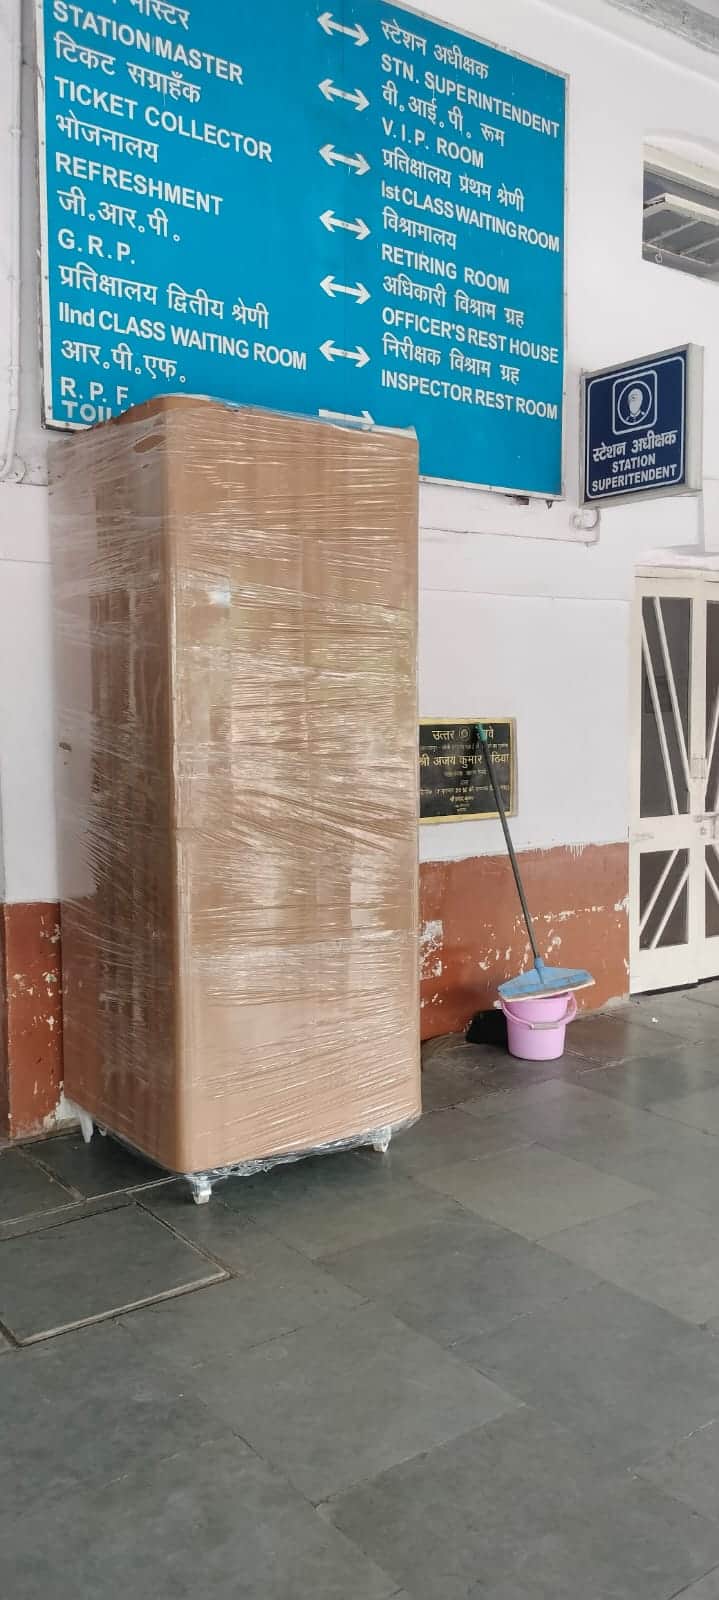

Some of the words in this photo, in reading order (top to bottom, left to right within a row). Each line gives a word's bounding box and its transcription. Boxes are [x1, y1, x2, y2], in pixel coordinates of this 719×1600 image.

[53, 1, 150, 53] STATION
[155, 36, 243, 85] MASTER
[54, 31, 116, 75] टिकट
[380, 20, 427, 56] स्टेशन
[433, 44, 489, 79] अधीक्षक
[55, 77, 137, 120] TICKET
[145, 106, 272, 162] COLLECTOR
[381, 54, 419, 84] STN.
[425, 72, 560, 138] SUPERINTENDENT
[56, 110, 159, 163] भोजनालय
[436, 139, 484, 168] ROOM
[480, 122, 505, 146] रूम
[55, 152, 223, 215] REFRESHMENT
[381, 147, 451, 188] प्रतिक्षालय
[496, 183, 524, 212] श्रेणी
[382, 206, 457, 250] विश्रामालय
[403, 188, 454, 219] CLASS
[454, 205, 515, 238] WAITING
[517, 221, 560, 252] ROOM
[59, 261, 158, 305] प्रतिक्षालय
[167, 283, 224, 320] द्वितीय
[232, 298, 269, 329] श्रेणी
[382, 243, 457, 279] RETIRING
[464, 266, 509, 294] ROOM
[383, 275, 447, 308] अधिकारी
[455, 290, 496, 320] विश्राम
[504, 307, 525, 328] ग्रह
[99, 311, 166, 341] CLASS
[170, 325, 249, 359] WAITING
[253, 343, 307, 370] ROOM
[382, 307, 465, 342] OFFICER'S
[468, 328, 507, 351] REST
[509, 337, 559, 364] HOUSE
[382, 333, 441, 366] निरीक्षक
[450, 348, 491, 378] विश्राम
[500, 364, 520, 384] ग्रह
[381, 369, 473, 404] INSPECTOR
[476, 388, 513, 413] REST
[516, 396, 558, 420] ROOM
[592, 441, 626, 462] स्टेशन
[631, 430, 678, 453] अधीक्षक
[612, 453, 655, 473] STATION
[592, 464, 677, 492] SUPERITENDENT
[433, 756, 456, 766] अजय
[459, 755, 482, 768] कुमार
